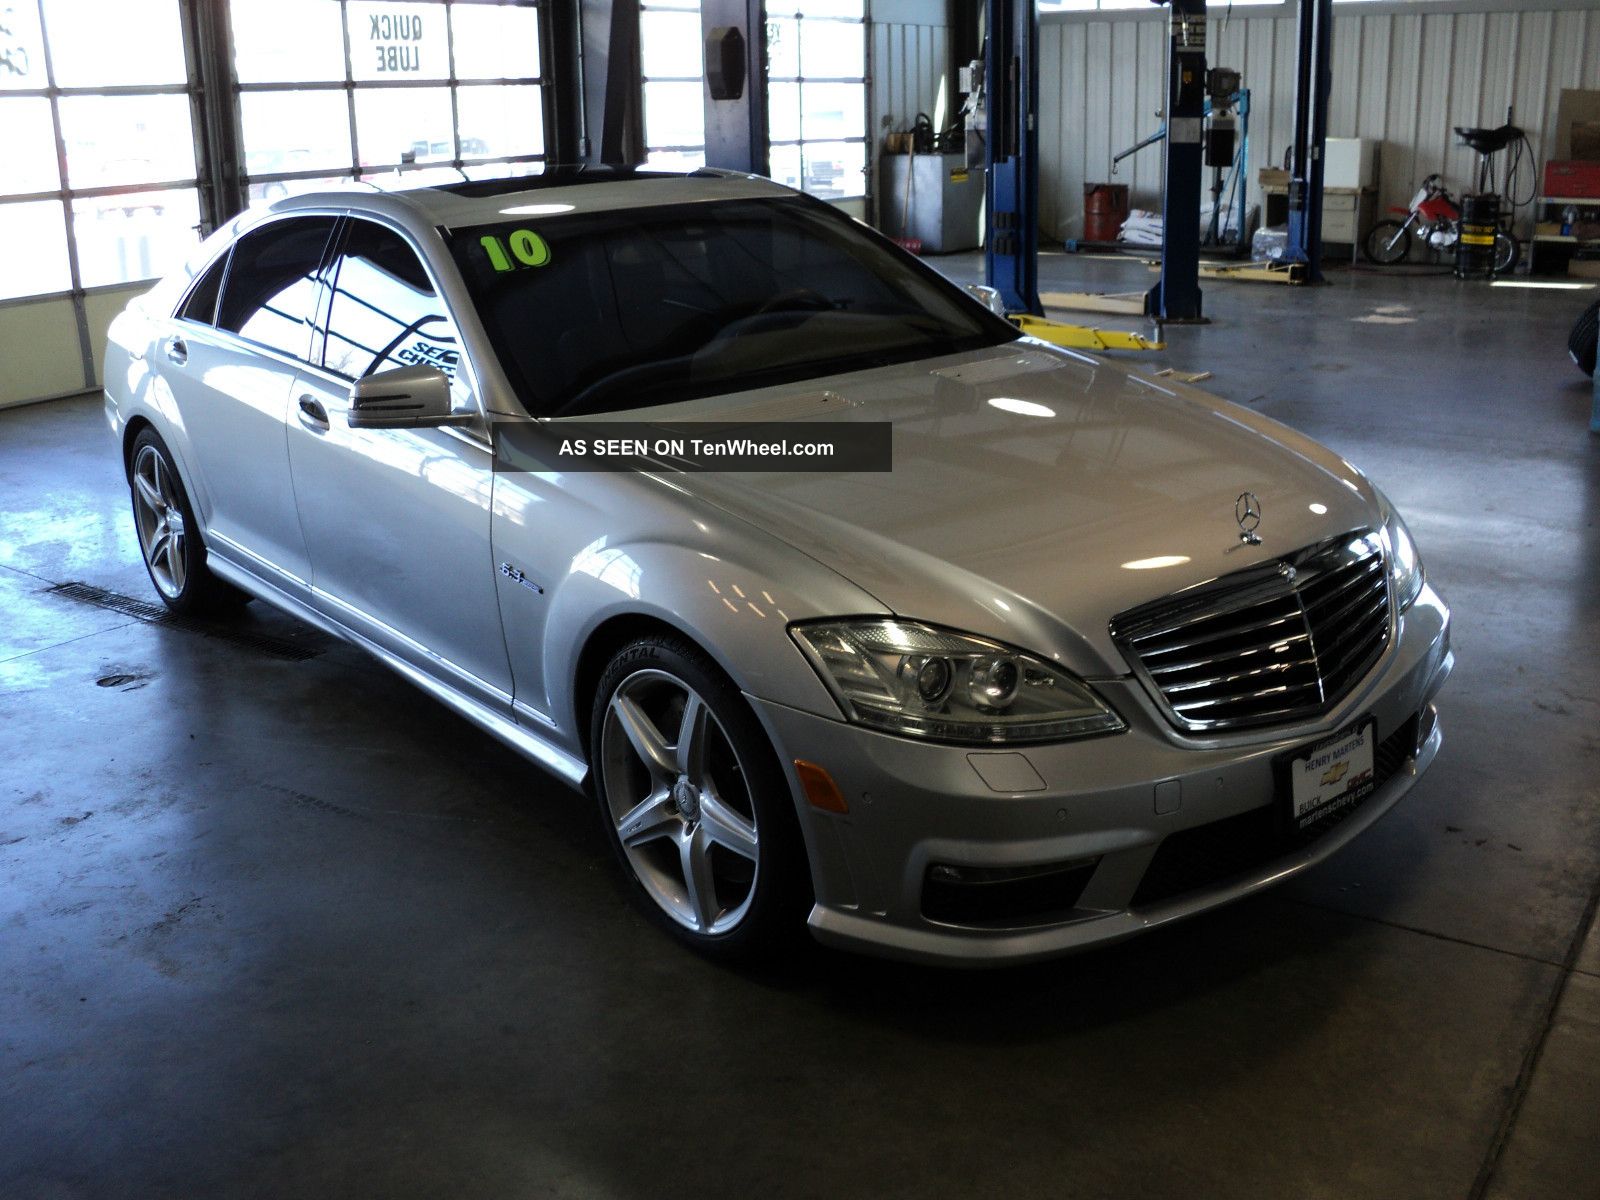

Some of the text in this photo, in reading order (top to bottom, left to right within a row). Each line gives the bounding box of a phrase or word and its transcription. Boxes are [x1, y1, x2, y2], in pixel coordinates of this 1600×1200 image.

[480, 229, 550, 271] 10
[1305, 752, 1331, 771] HENRY
[1333, 734, 1364, 760] MARTENS
[1299, 794, 1321, 814] BUICK
